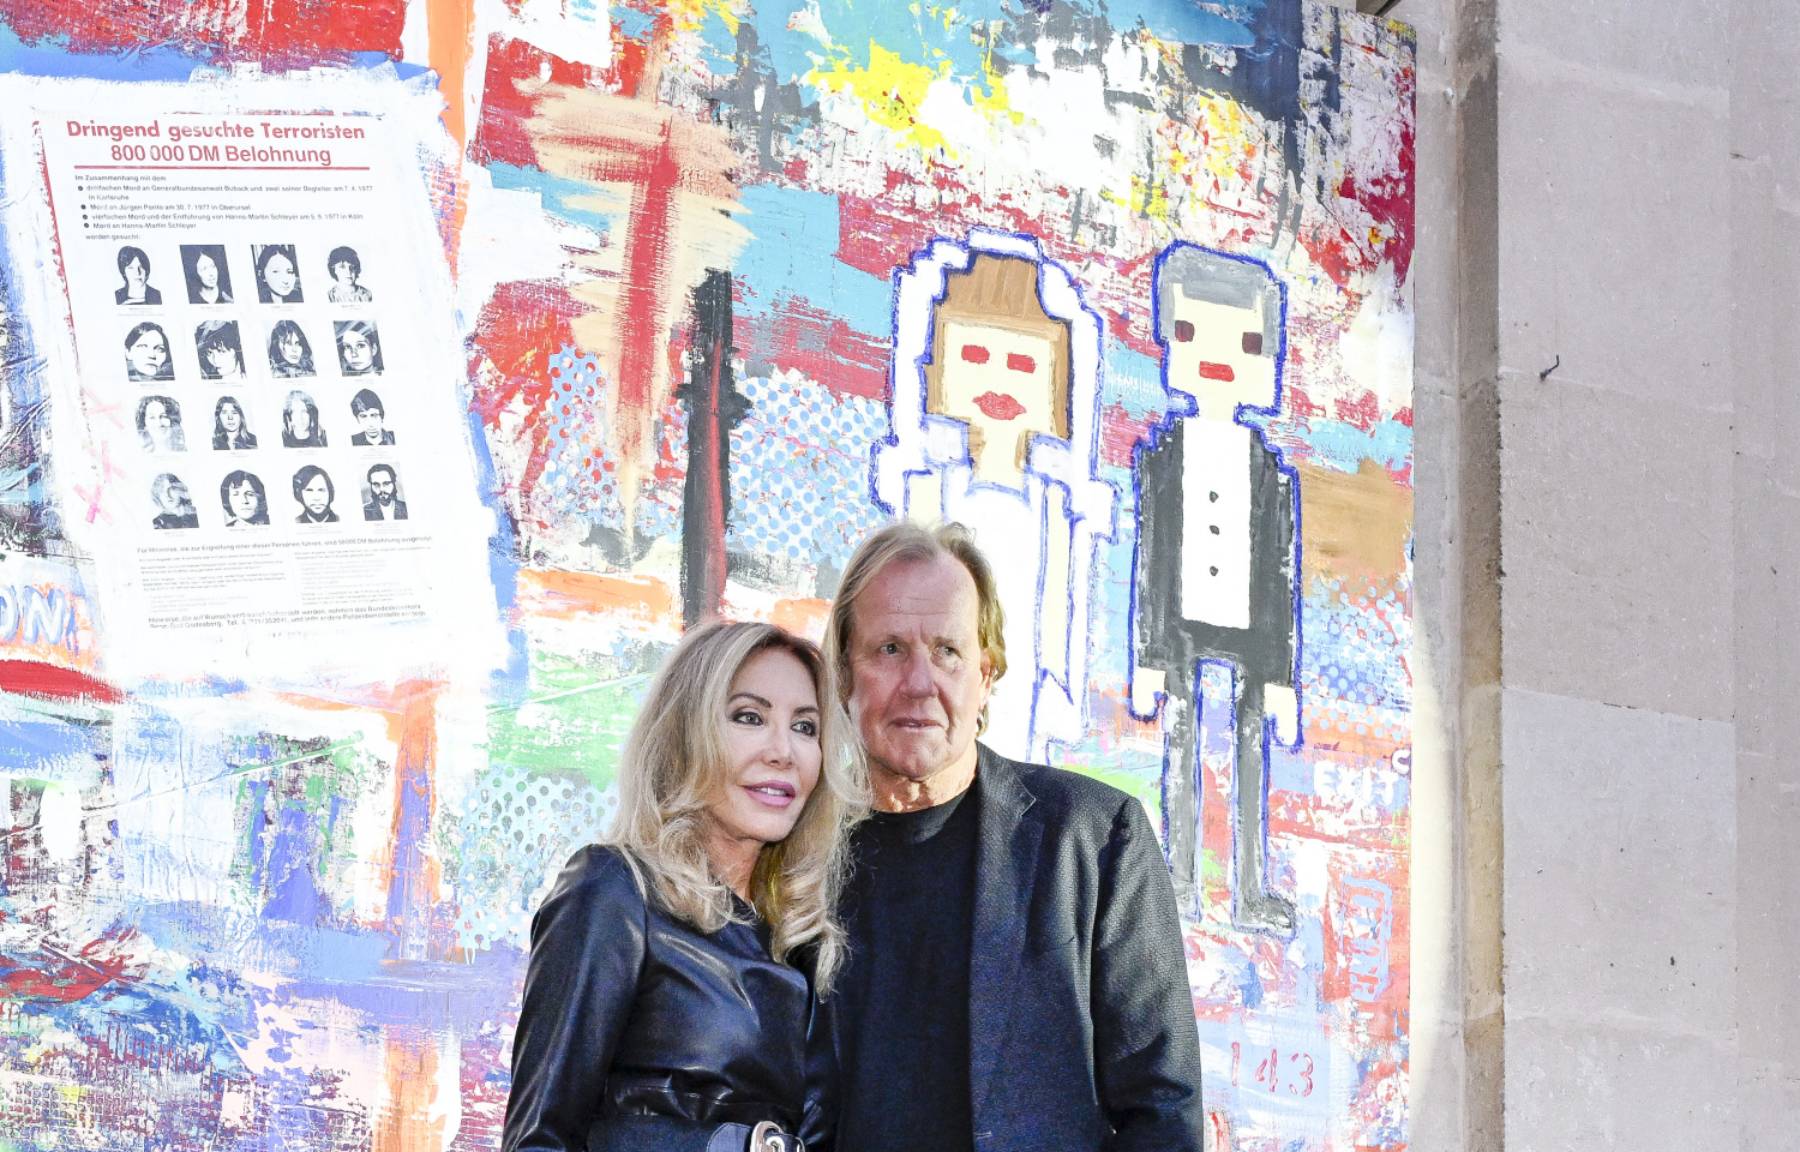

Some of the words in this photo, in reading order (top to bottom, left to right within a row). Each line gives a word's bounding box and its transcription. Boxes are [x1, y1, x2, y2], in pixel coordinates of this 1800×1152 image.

[67, 120, 160, 141] Dringend
[168, 121, 254, 141] gesuchte
[260, 122, 365, 139] Terroristen
[110, 145, 146, 161] 800
[149, 145, 184, 161] 000
[188, 145, 219, 161] DM
[225, 146, 331, 166] Belohnung
[85, 175, 138, 183] Zusammenhang
